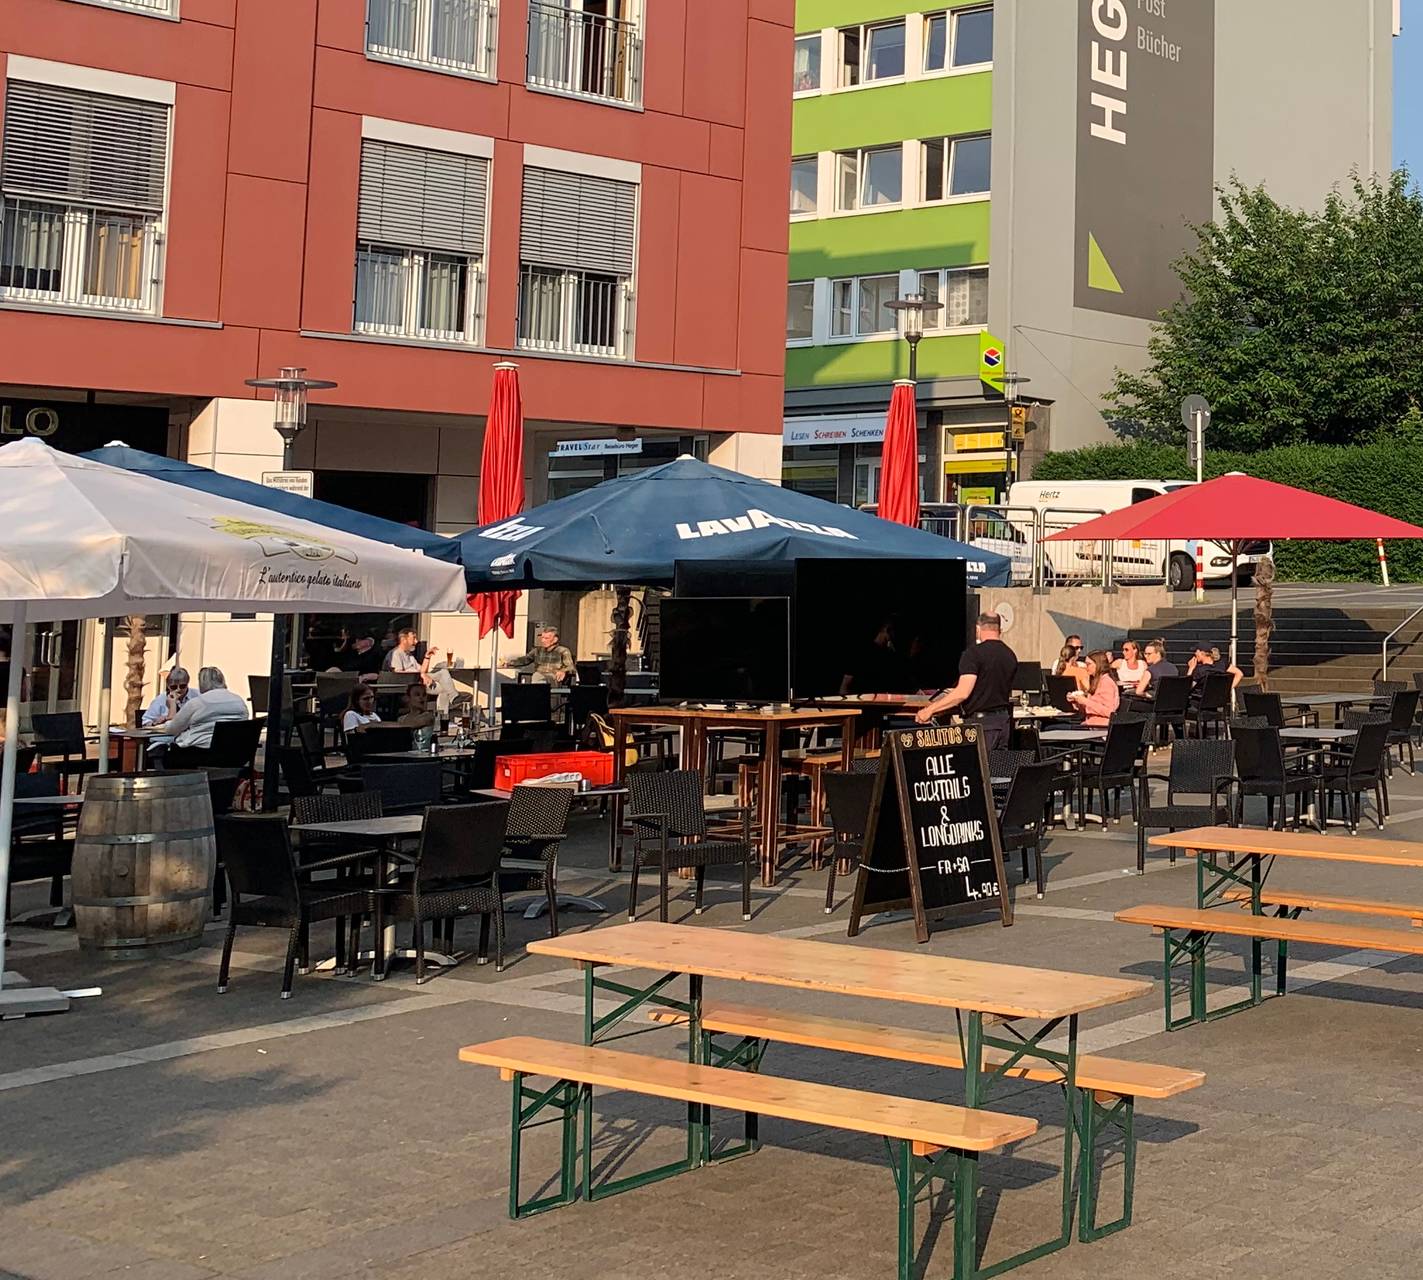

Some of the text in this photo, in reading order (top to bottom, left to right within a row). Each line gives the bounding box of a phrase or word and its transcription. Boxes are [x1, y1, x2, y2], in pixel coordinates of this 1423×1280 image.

[1137, 26, 1182, 62] Bücher
[1, 405, 59, 436] LO
[791, 428, 884, 440] LESEN SCHREIBEN SCHENKEN
[1039, 490, 1061, 499] Hertz
[306, 569, 331, 589] gelato
[332, 573, 362, 589] italiano
[916, 726, 963, 748] SALITOS
[925, 753, 956, 776] ALLE
[914, 776, 971, 802] COCKTAILS
[940, 805, 951, 825] &
[920, 820, 984, 848] LONGDRINKS
